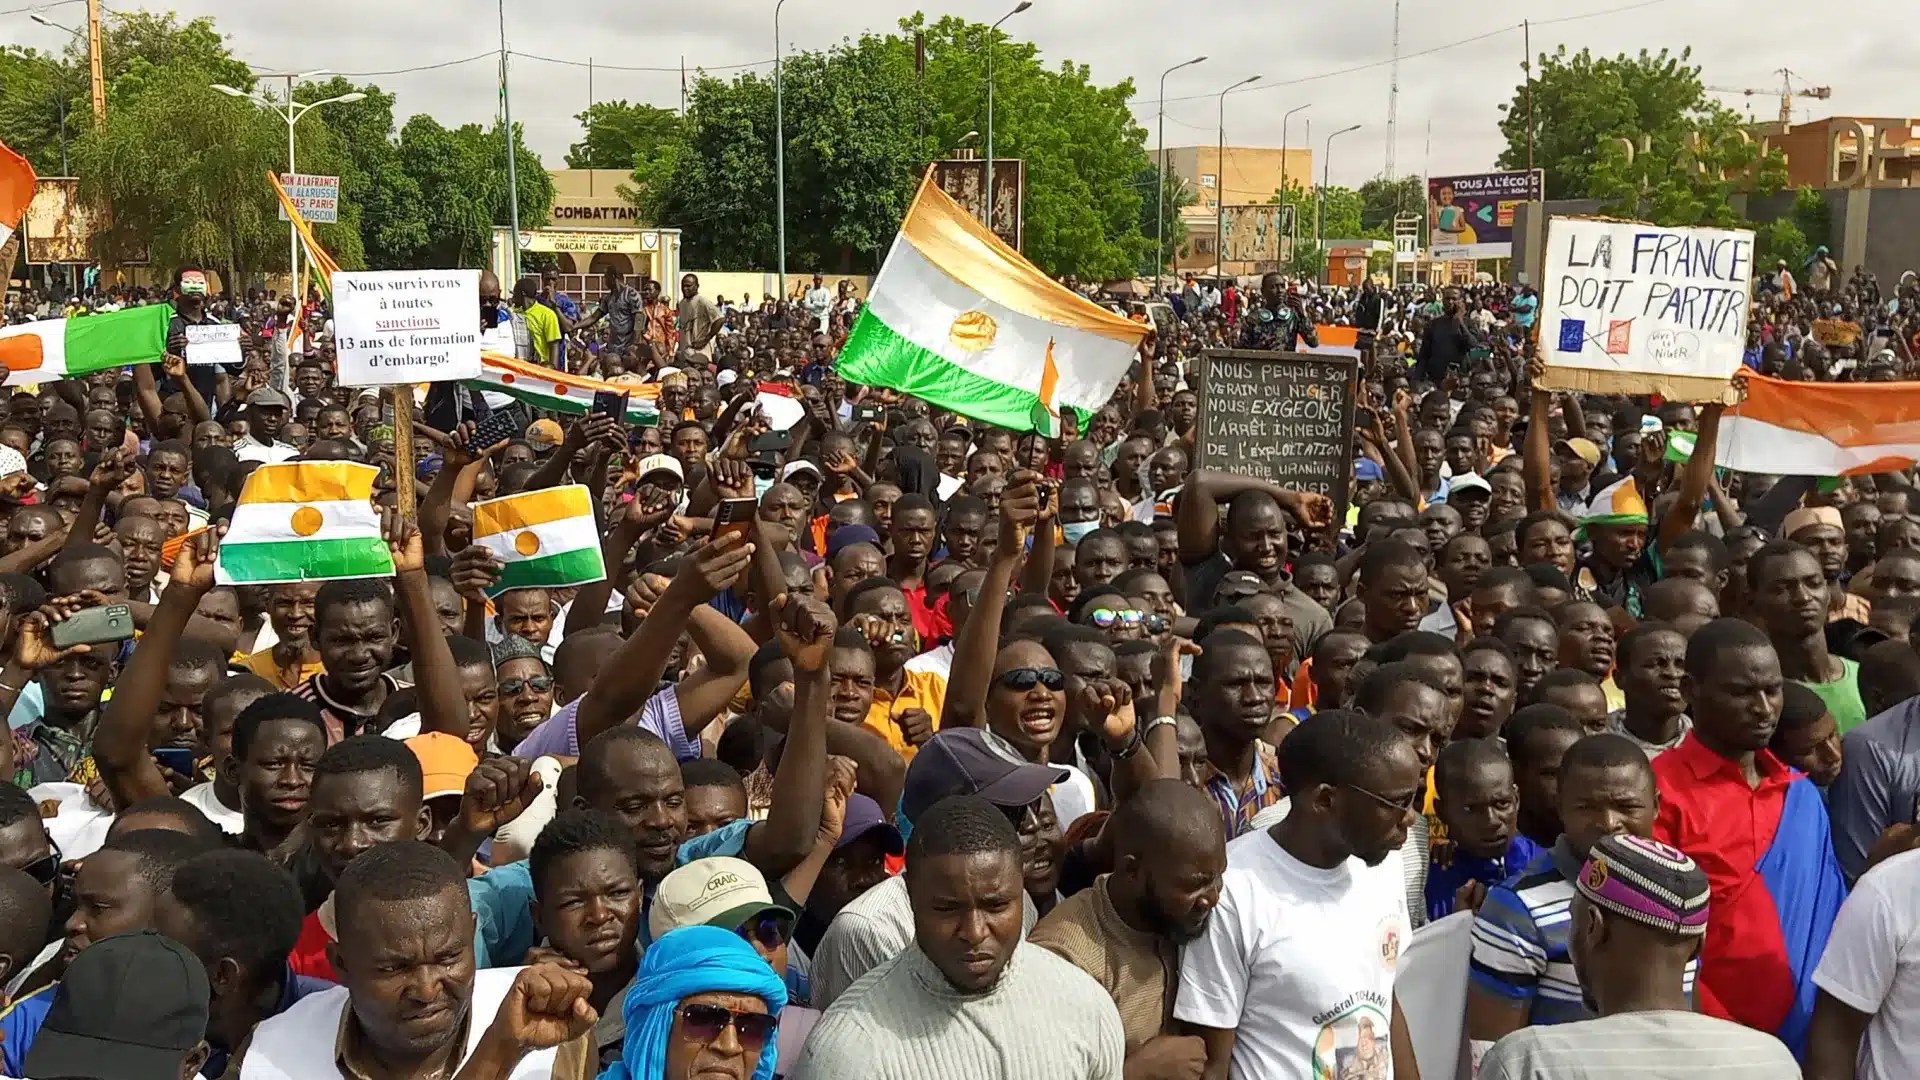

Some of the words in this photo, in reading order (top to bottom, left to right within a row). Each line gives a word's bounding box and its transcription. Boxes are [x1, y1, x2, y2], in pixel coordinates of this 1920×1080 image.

[1453, 179, 1482, 189] TOUS
[1484, 177, 1493, 187] À
[310, 199, 334, 209] PARIS
[302, 209, 336, 220] MOSCOU
[554, 206, 641, 219] COMBATTAN
[555, 242, 585, 250] ONACAM
[1567, 233, 1613, 269] LA
[1631, 233, 1750, 282] FRANCE
[347, 279, 383, 292] Nous
[388, 277, 460, 291] survivrons
[380, 297, 387, 309] à
[393, 298, 433, 309] toutes
[1643, 282, 1745, 336] PARTIR
[376, 315, 440, 329] sanctions
[338, 337, 354, 350] 13
[359, 338, 384, 349] ans
[389, 335, 404, 347] de
[410, 332, 475, 347] formation
[1210, 361, 1252, 379] NOUS
[1207, 381, 1258, 397] VERAIN
[1264, 384, 1280, 397] DU
[1288, 383, 1343, 400] NIGER
[1208, 398, 1246, 412] NOUS
[1251, 398, 1342, 422] EXIGEONS
[1207, 442, 1228, 455] DE
[707, 873, 738, 891] CRAIG
[1312, 994, 1354, 1025] Général
